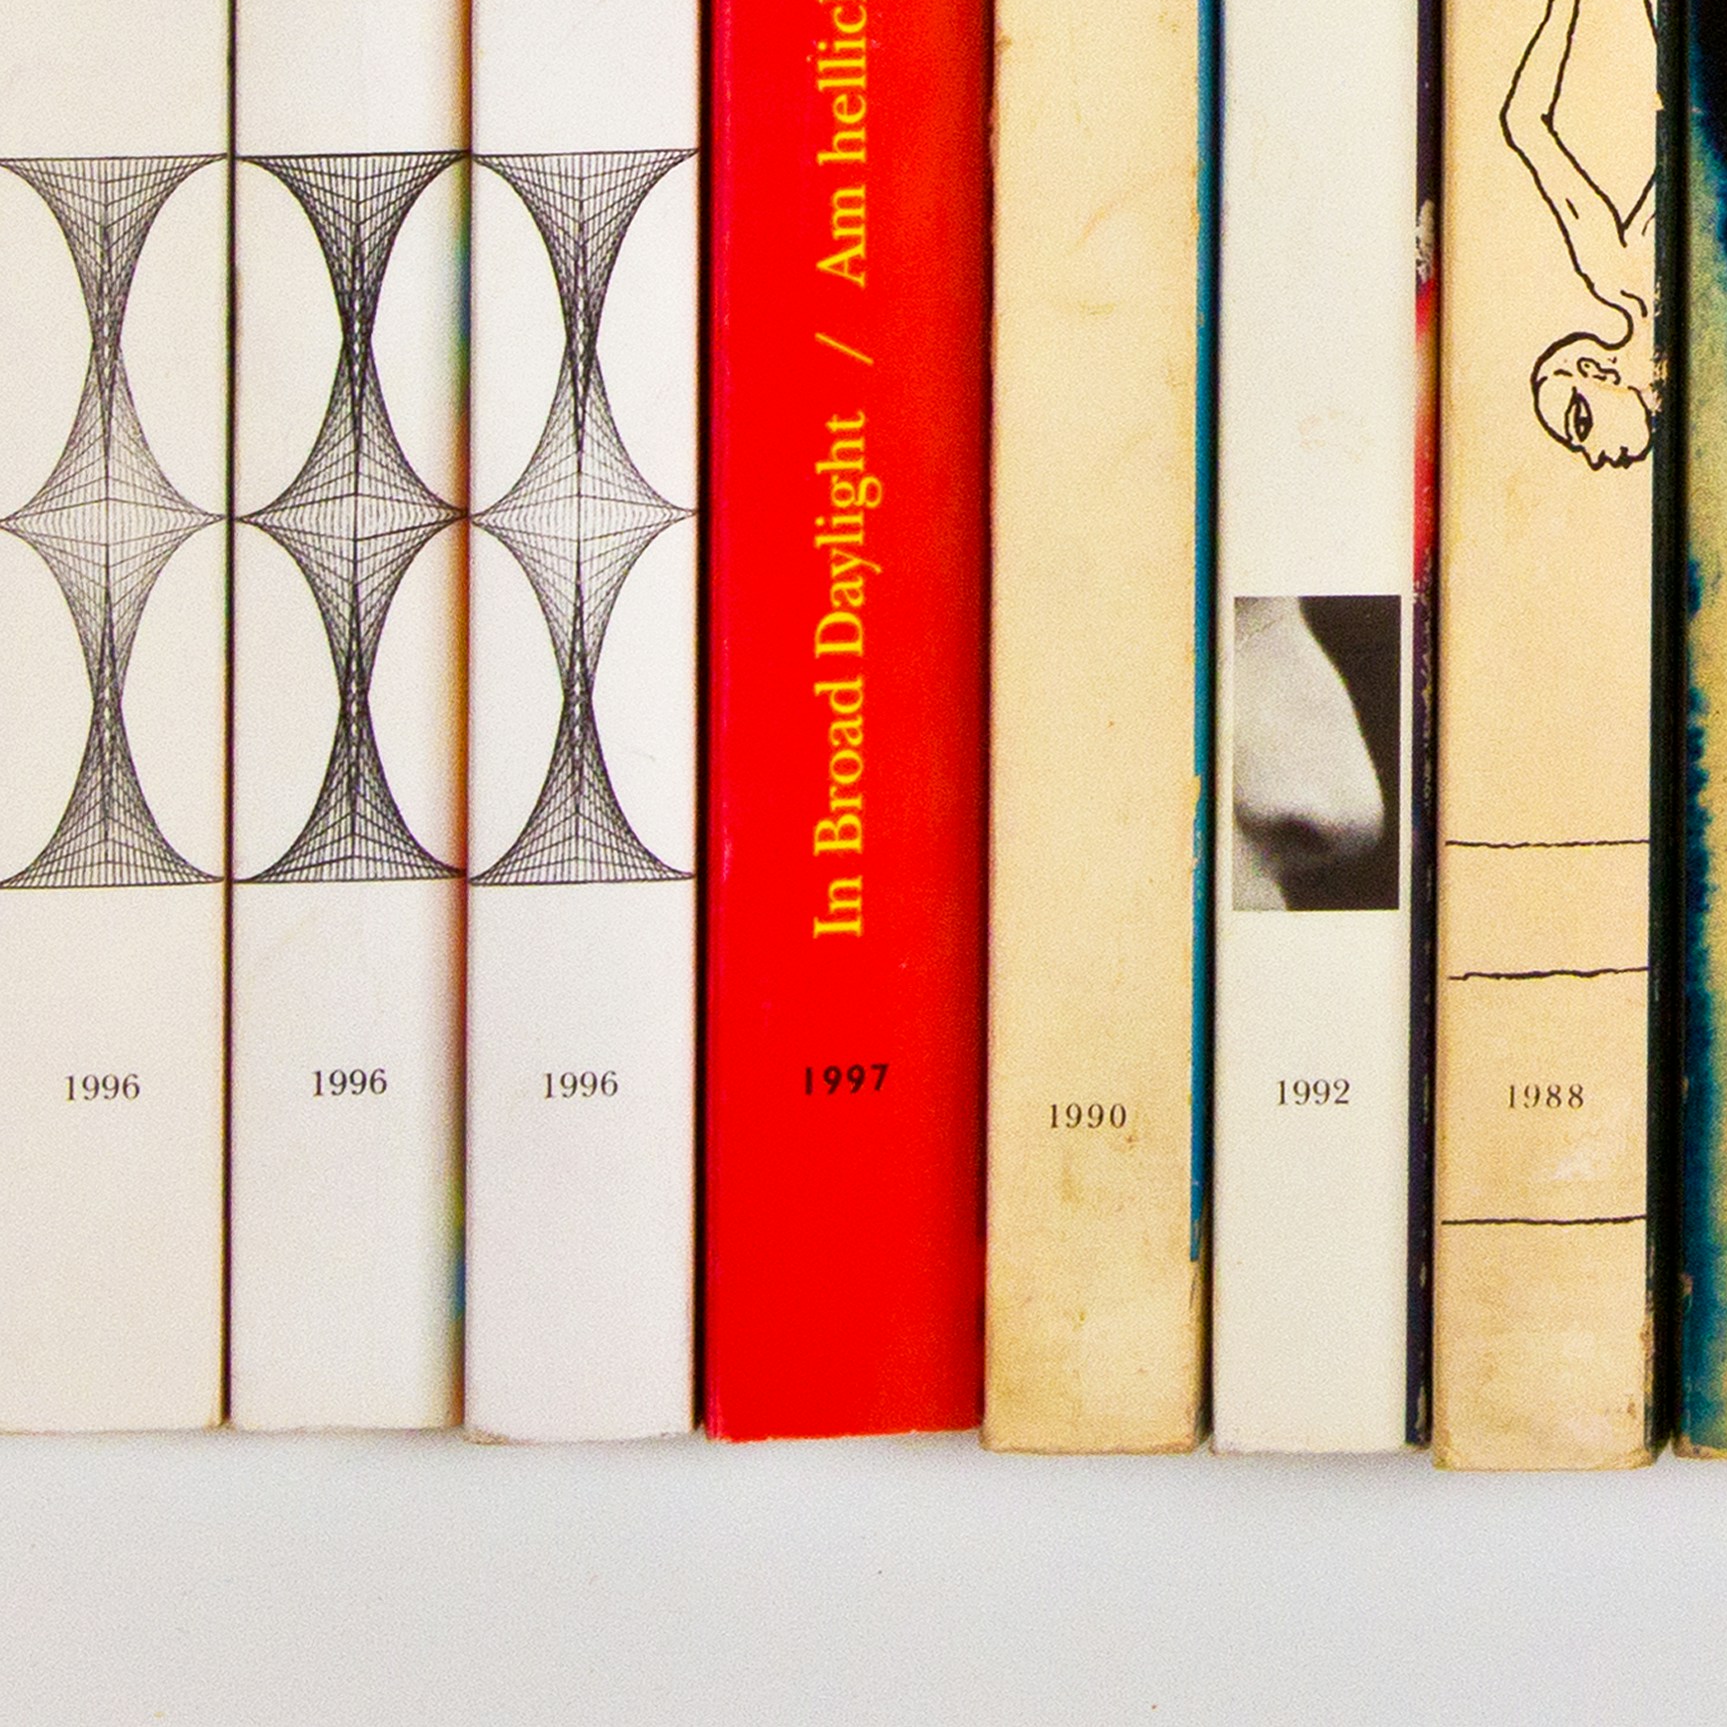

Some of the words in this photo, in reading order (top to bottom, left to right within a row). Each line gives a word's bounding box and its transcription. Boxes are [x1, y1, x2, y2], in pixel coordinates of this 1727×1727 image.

[816, 185, 866, 287] Am
[814, 411, 882, 657] Daylight
[813, 676, 864, 855] Broad
[813, 876, 863, 937] In
[67, 1073, 141, 1102] 1996
[314, 1068, 388, 1097] 1996
[545, 1070, 619, 1099] 1996
[804, 1063, 889, 1096] 1997
[1278, 1079, 1351, 1106] 1992
[1508, 1084, 1584, 1109] 1988
[1050, 1103, 1127, 1129] 1990
